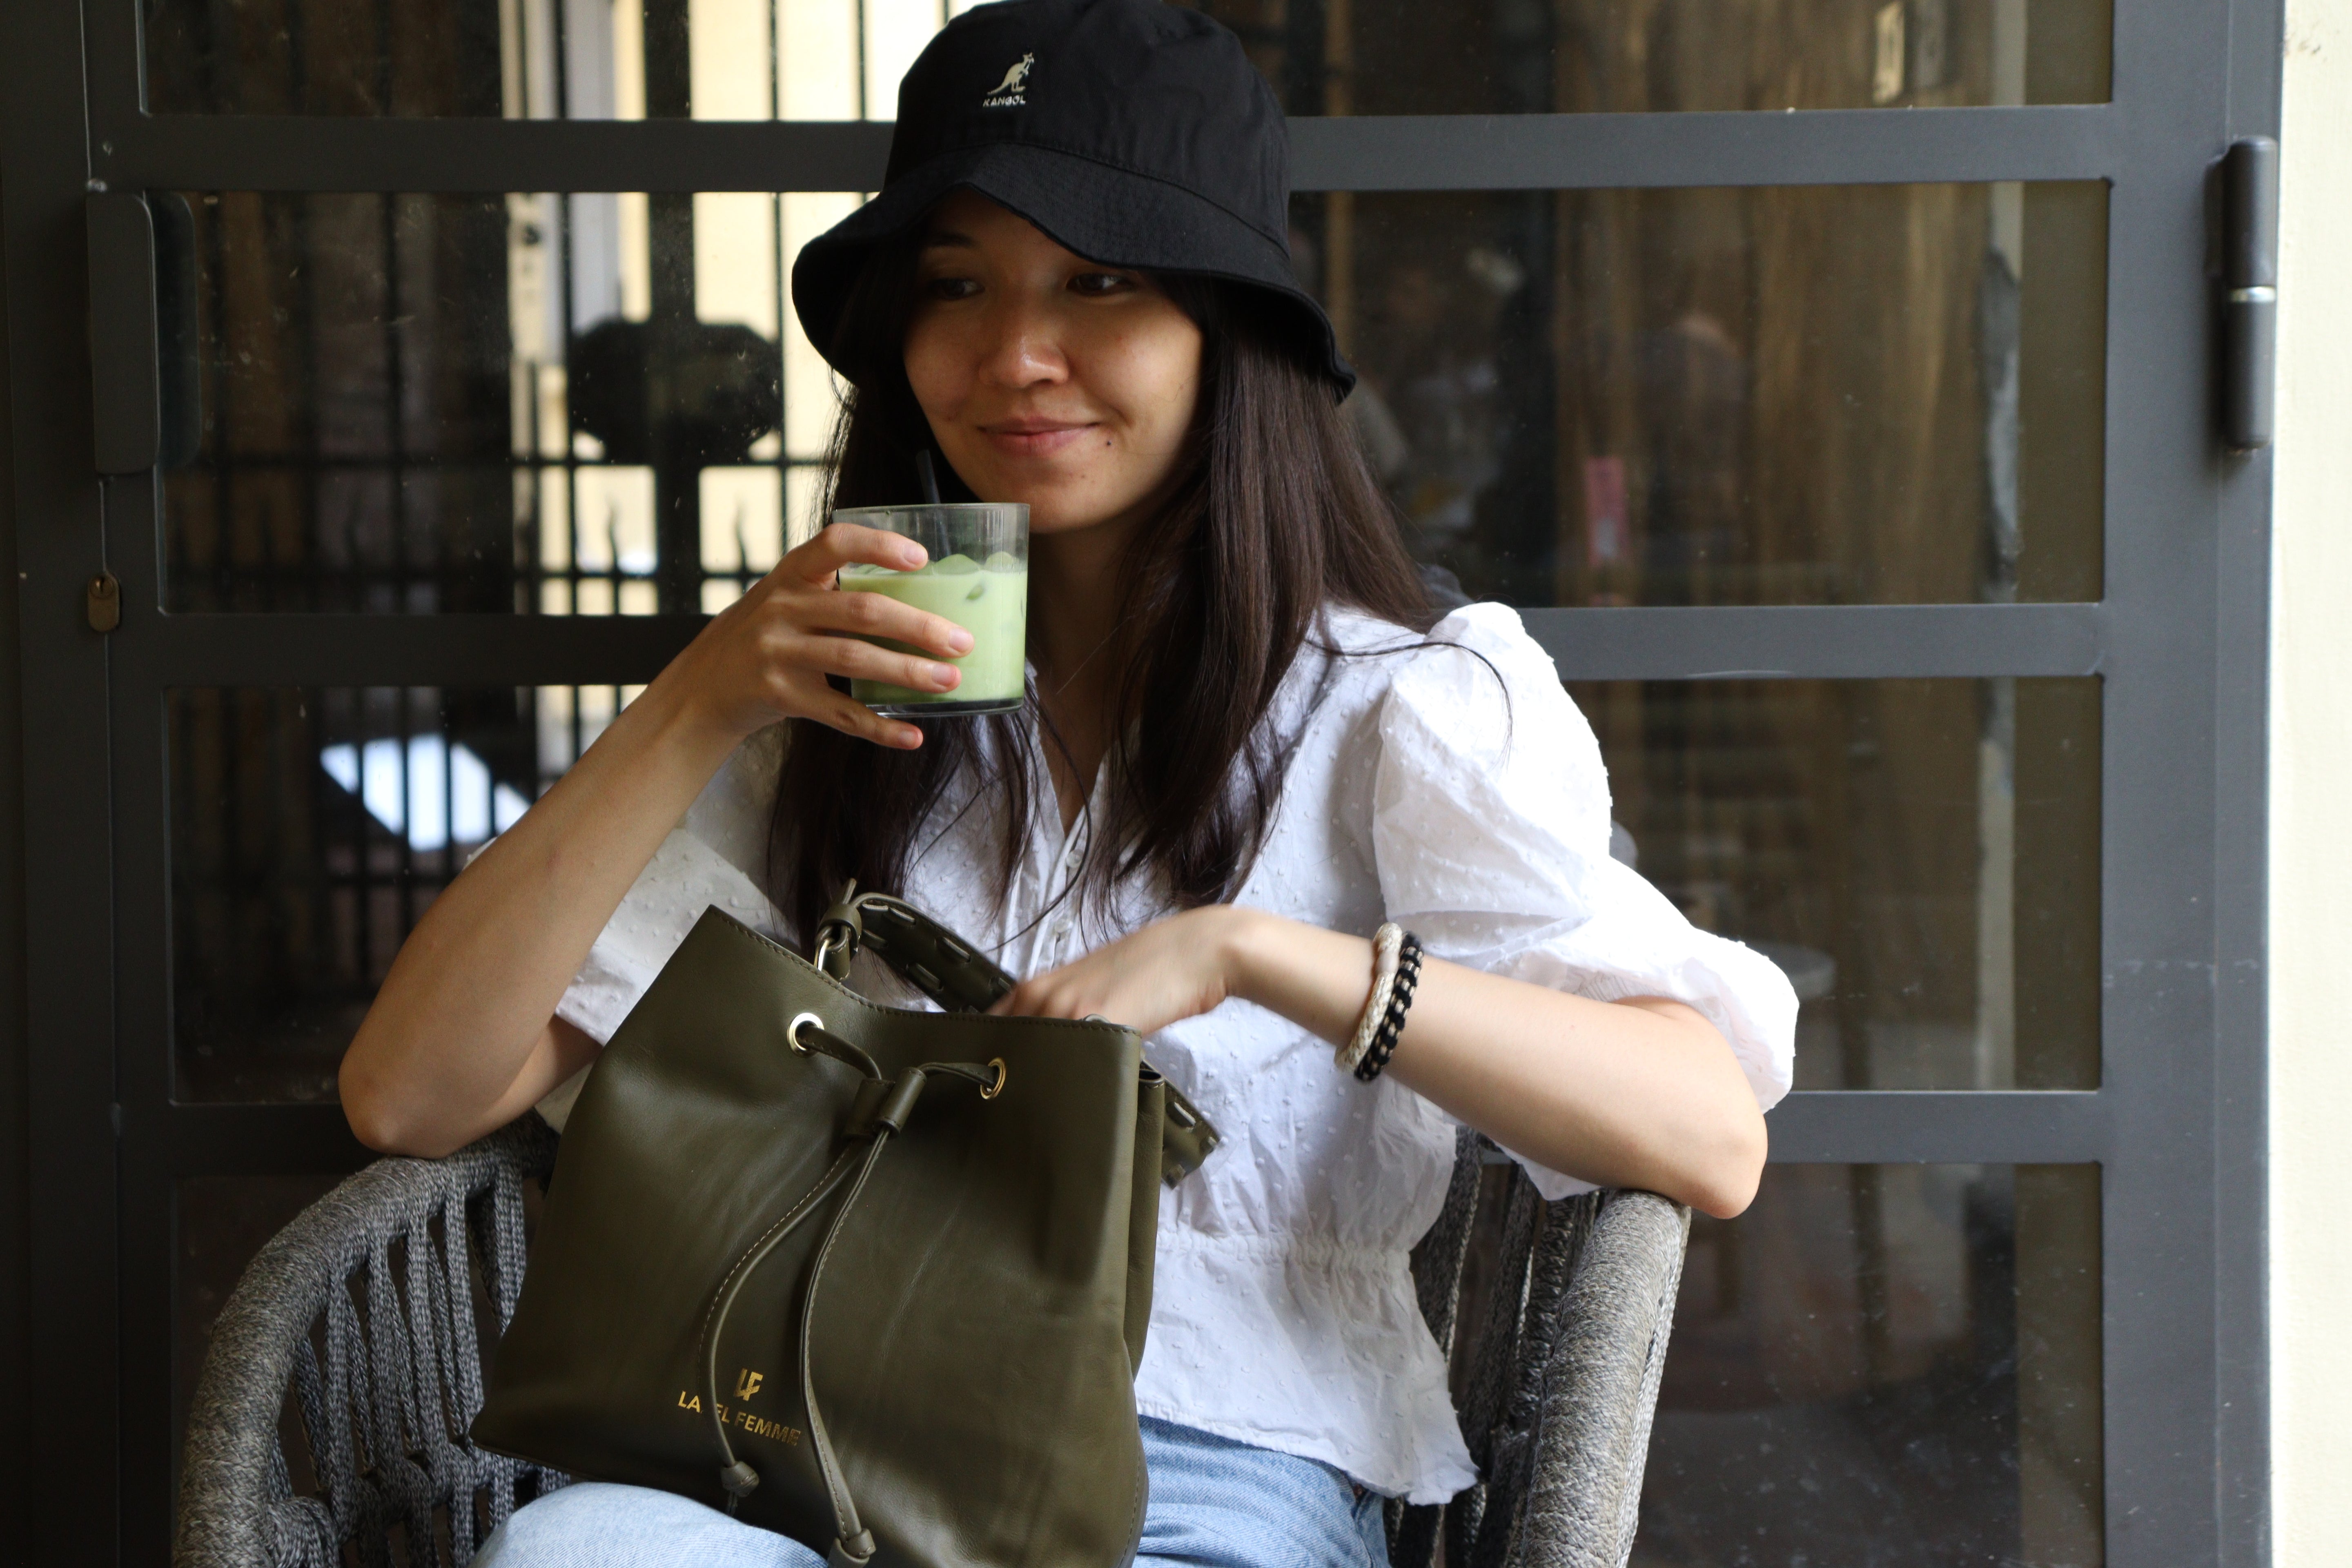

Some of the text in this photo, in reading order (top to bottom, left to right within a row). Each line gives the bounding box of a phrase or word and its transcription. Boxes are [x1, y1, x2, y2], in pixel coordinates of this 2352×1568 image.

[982, 94, 1026, 107] KANGOL
[678, 1390, 801, 1446] LAL FEMME
